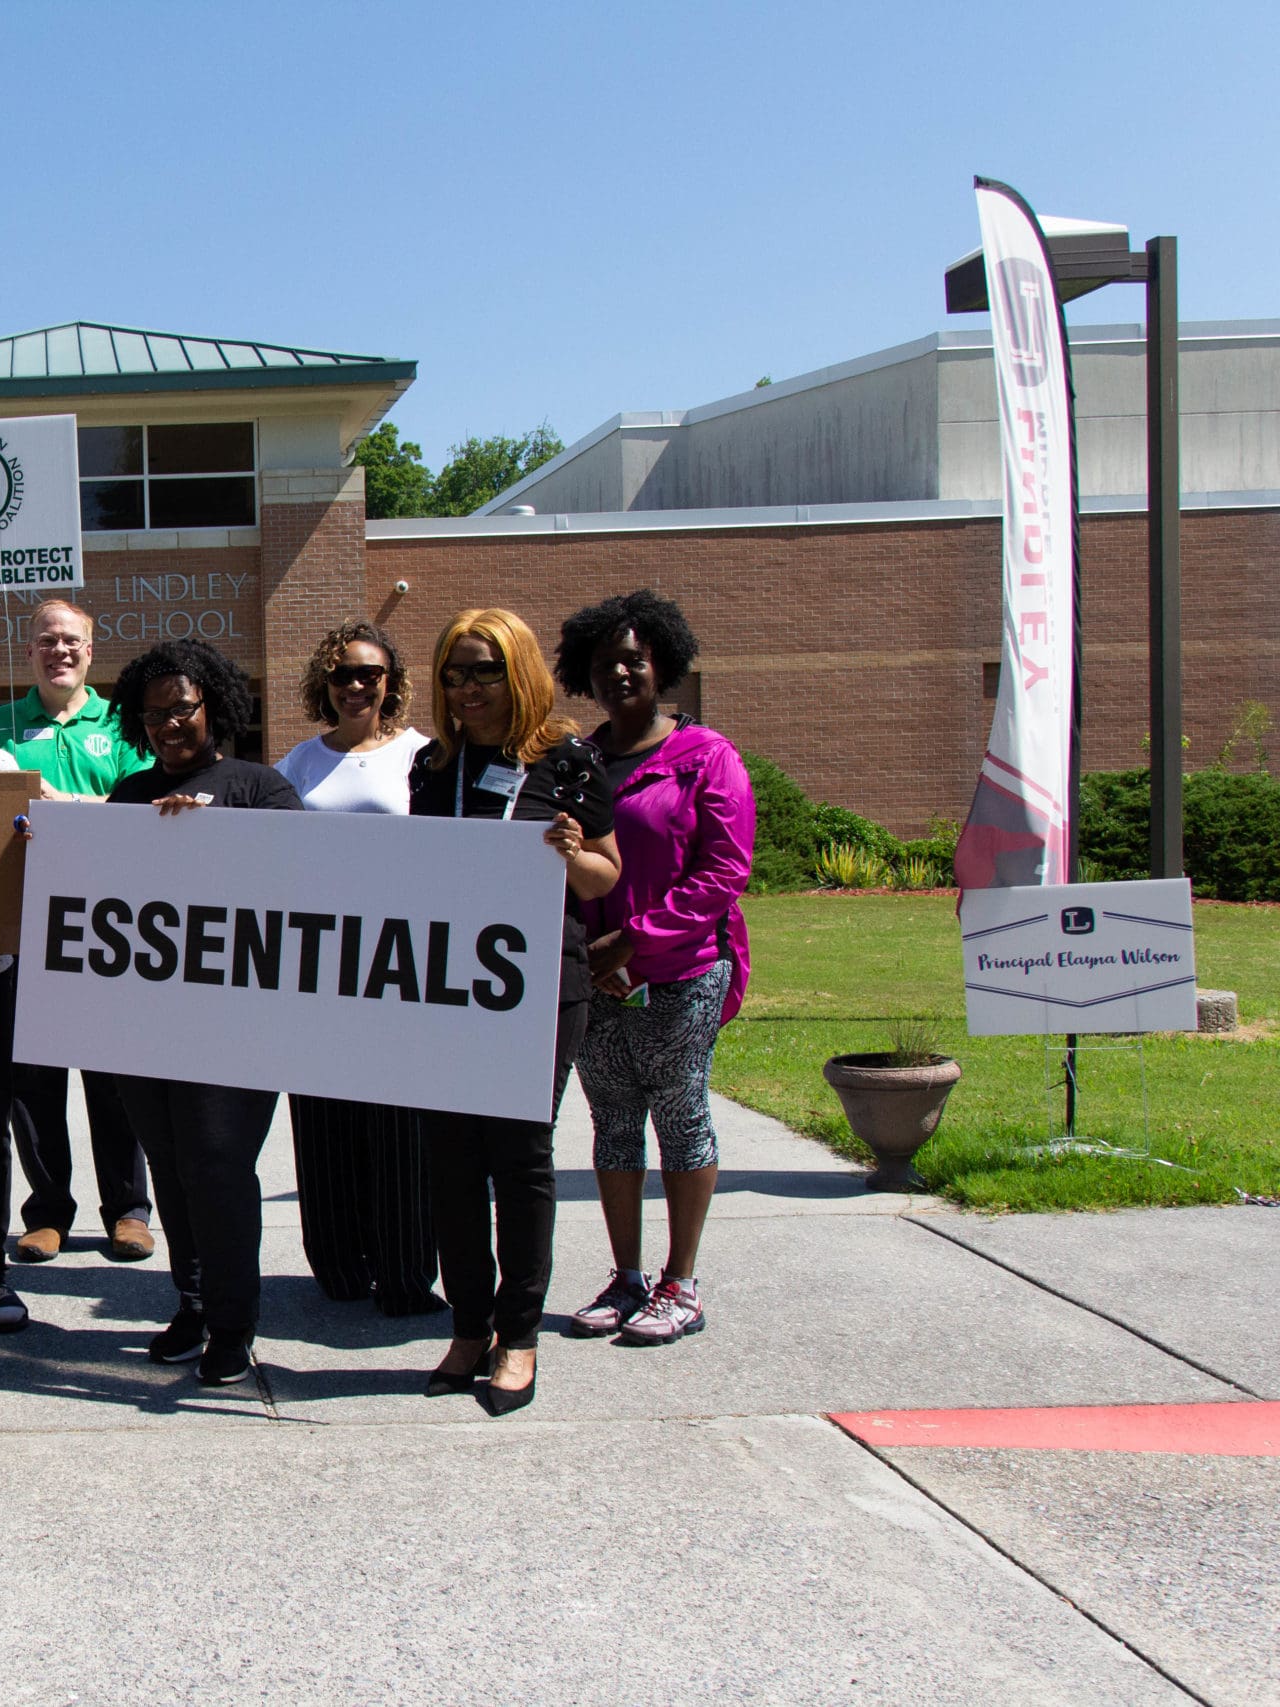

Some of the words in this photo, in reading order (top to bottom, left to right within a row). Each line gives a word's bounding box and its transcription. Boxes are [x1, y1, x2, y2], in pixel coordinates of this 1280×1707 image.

[115, 572, 247, 603] LINDLEY
[97, 610, 242, 641] SCHOOL
[45, 895, 527, 1012] ESSENTIALS
[977, 951, 1053, 975] Principal
[1057, 950, 1119, 969] Elayna
[1121, 948, 1181, 965] Wilson
